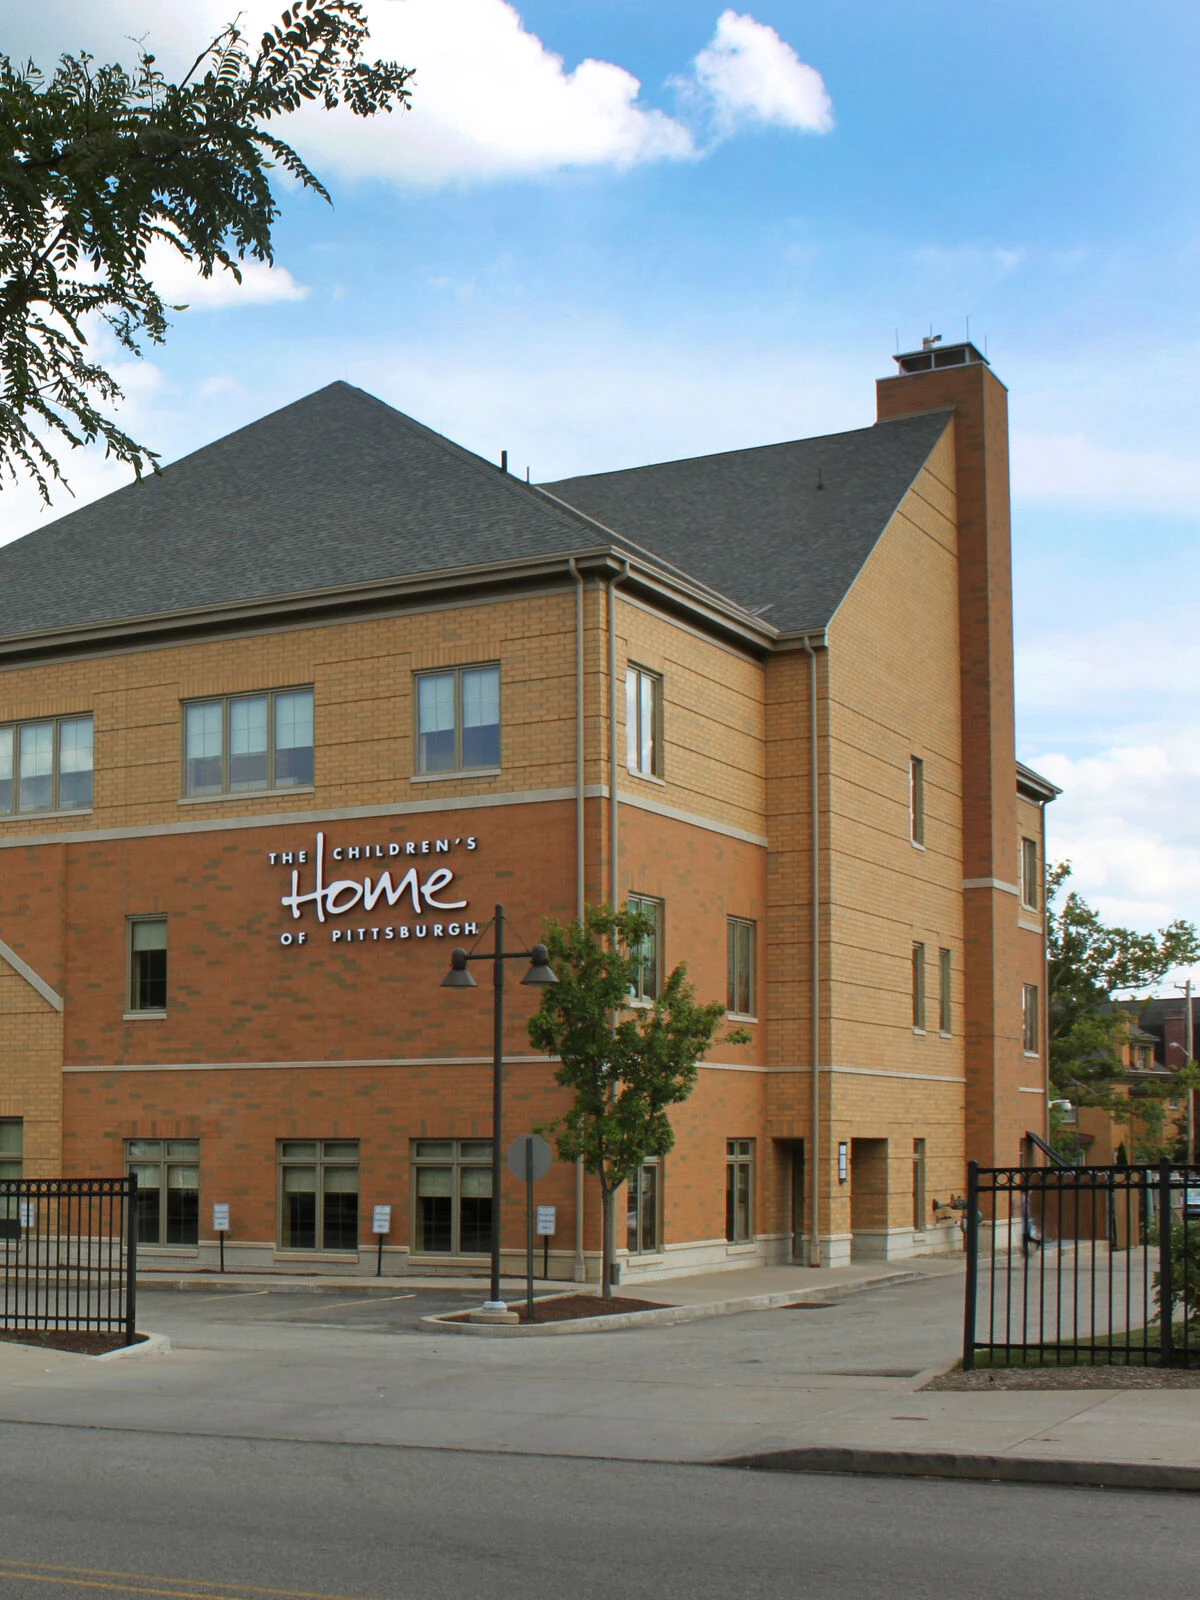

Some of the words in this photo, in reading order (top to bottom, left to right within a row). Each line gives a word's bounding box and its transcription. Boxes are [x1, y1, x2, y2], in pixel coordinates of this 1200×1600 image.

[269, 851, 307, 865] THE
[333, 837, 477, 860] CHILDREN'S
[280, 932, 306, 945] OF
[332, 922, 477, 942] PITTSBURGH
